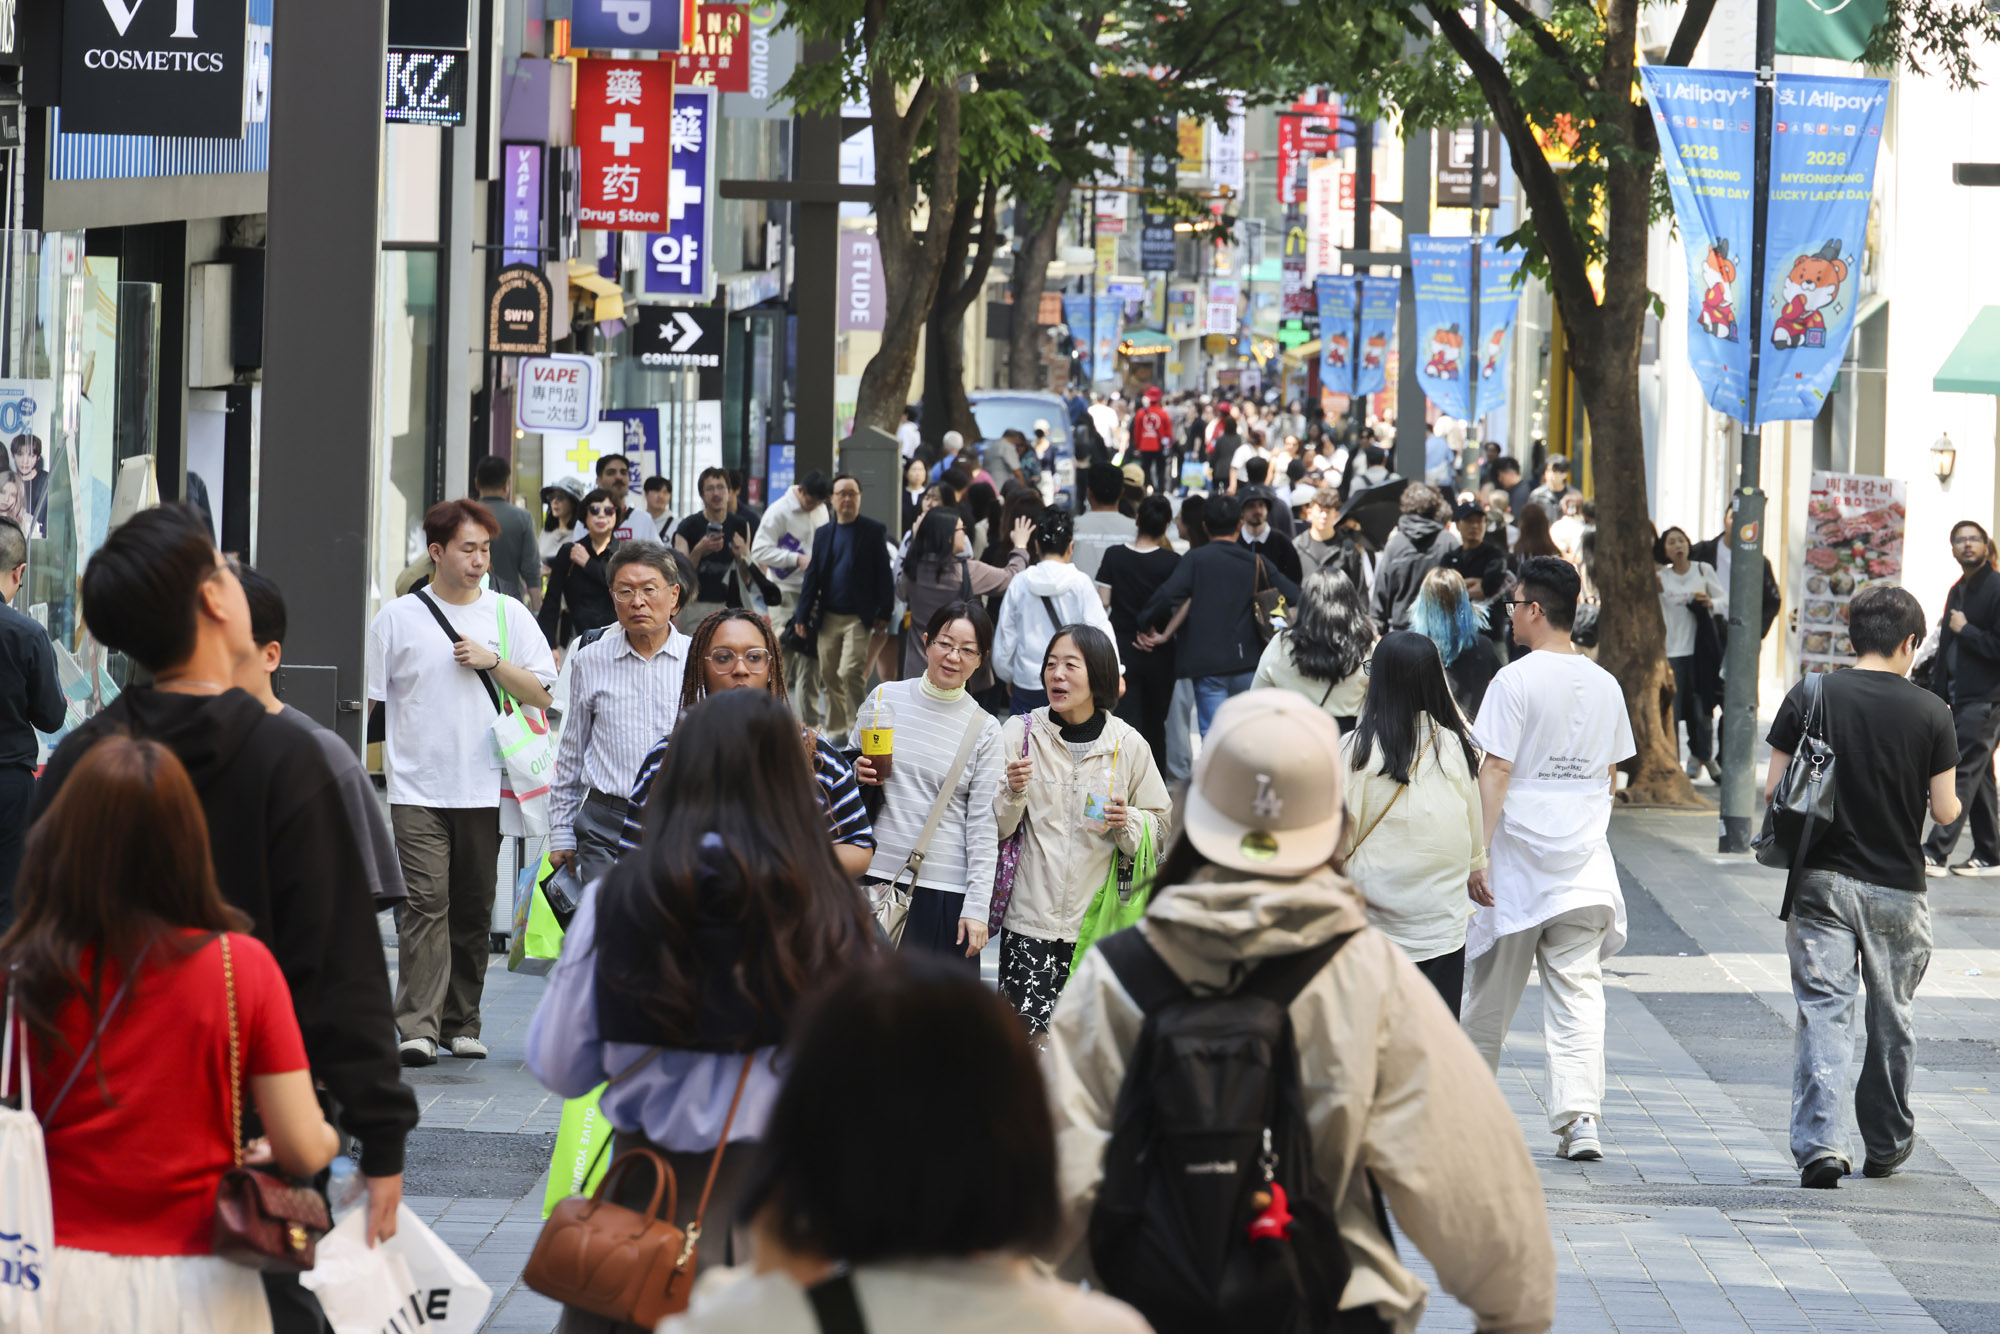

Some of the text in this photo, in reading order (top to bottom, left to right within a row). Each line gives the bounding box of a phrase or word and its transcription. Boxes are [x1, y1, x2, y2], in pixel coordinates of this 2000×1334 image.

[85, 49, 223, 72] COSMETICS
[752, 27, 770, 99] YOUNG
[605, 69, 642, 105] 藥
[1672, 82, 1751, 107] Alipay+
[1806, 89, 1884, 113] Alipay+
[1679, 144, 1719, 161] 2026
[1806, 151, 1846, 166] 2026
[516, 149, 531, 198] VAPE
[602, 164, 640, 202] 药
[1780, 172, 1865, 184] MYEONGDONG
[1727, 188, 1750, 200] DAY
[1771, 189, 1873, 201] LUCKY LABOR DAY
[581, 207, 660, 225] Drug Store
[652, 234, 698, 286] 약
[851, 242, 873, 324] ETUDE
[641, 352, 719, 367] CONVERSE
[534, 366, 580, 384] VAPE
[531, 406, 578, 423] 一次性
[570, 1107, 596, 1193] OLIVE YOUNG
